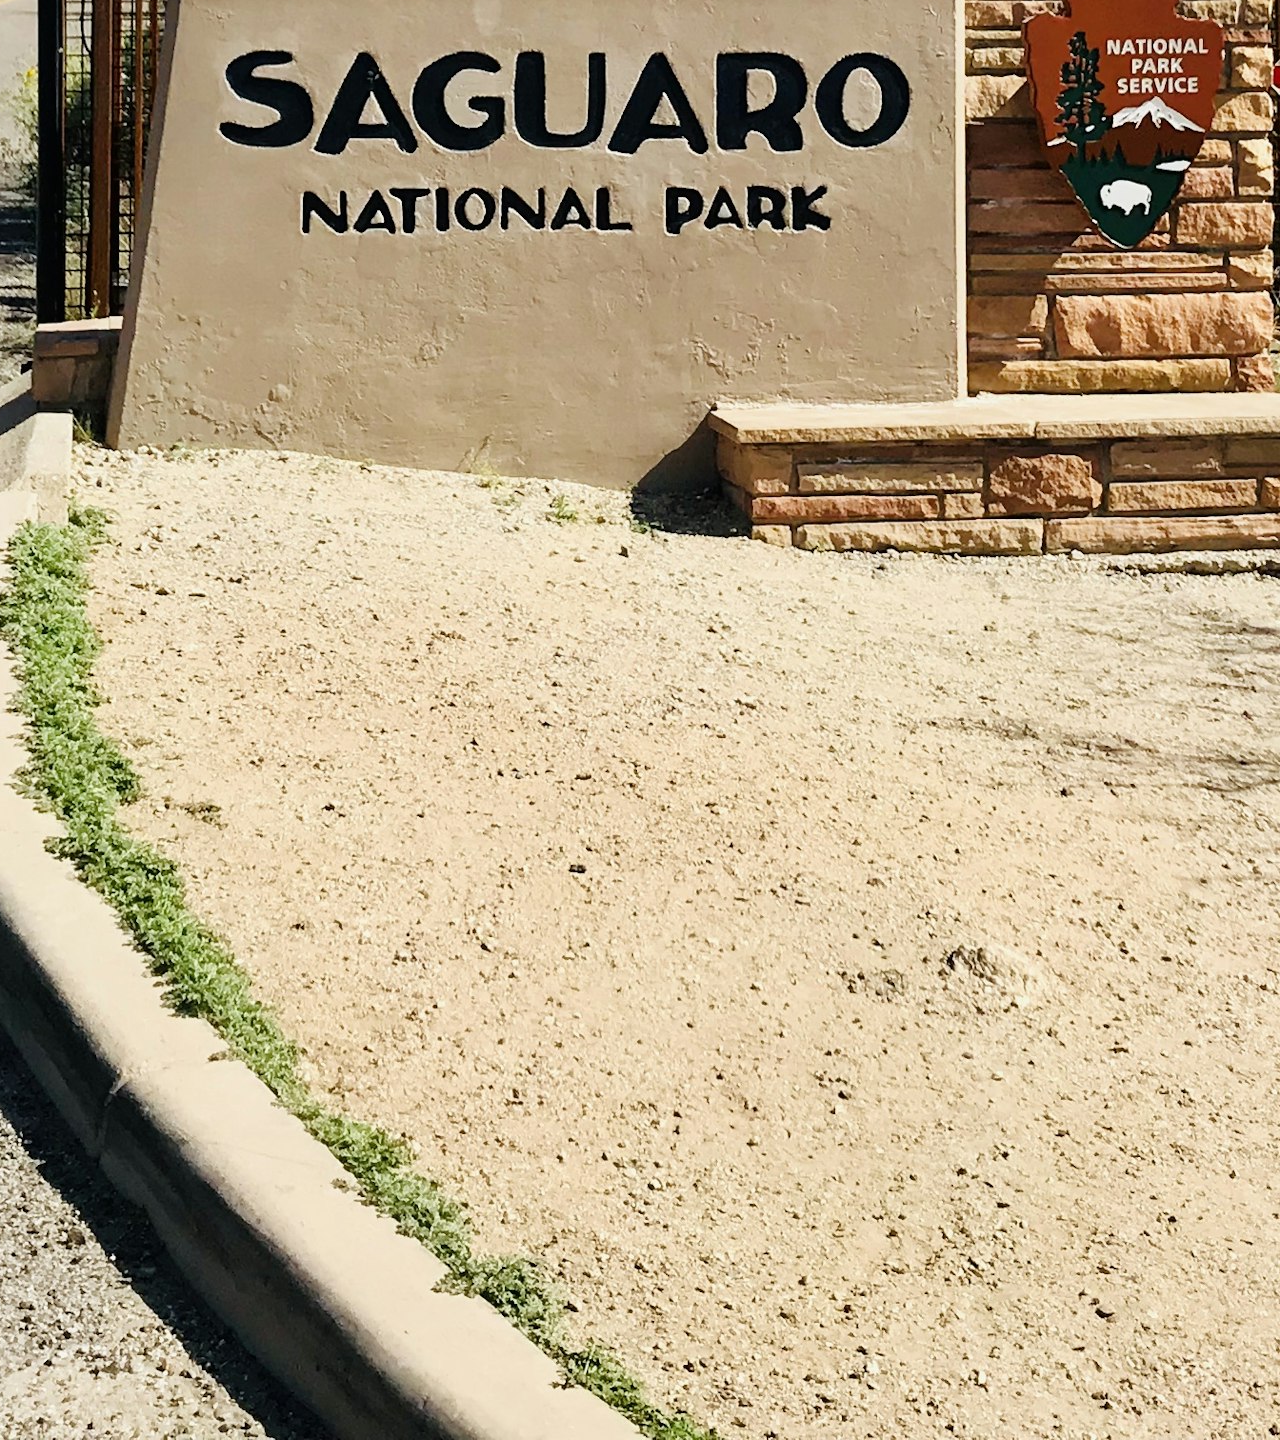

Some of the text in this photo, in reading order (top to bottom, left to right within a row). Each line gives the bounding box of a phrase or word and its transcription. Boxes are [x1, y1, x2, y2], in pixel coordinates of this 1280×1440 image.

[1106, 38, 1209, 55] NATIONAL
[1131, 57, 1184, 75] PARK
[1116, 77, 1199, 94] SERVICE
[219, 50, 911, 156] SAGUARO
[301, 185, 832, 235] NATIONAL PARK
